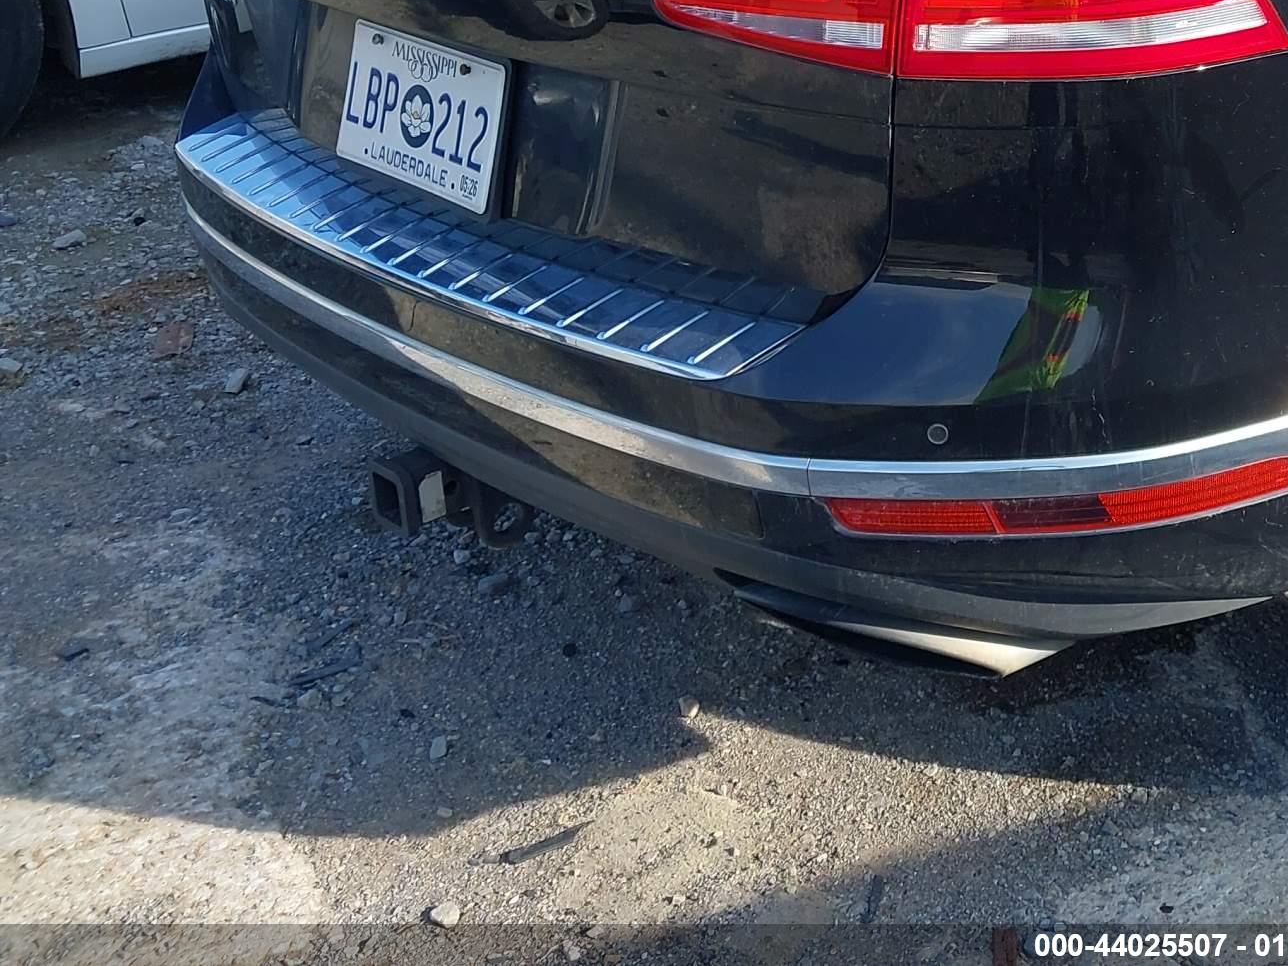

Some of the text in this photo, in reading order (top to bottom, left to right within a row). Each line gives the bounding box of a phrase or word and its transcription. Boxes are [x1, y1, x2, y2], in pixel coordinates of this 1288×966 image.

[391, 41, 458, 83] MISSISSIPPI
[346, 61, 489, 173] LBP 212
[370, 141, 449, 188] LAUDERDALE
